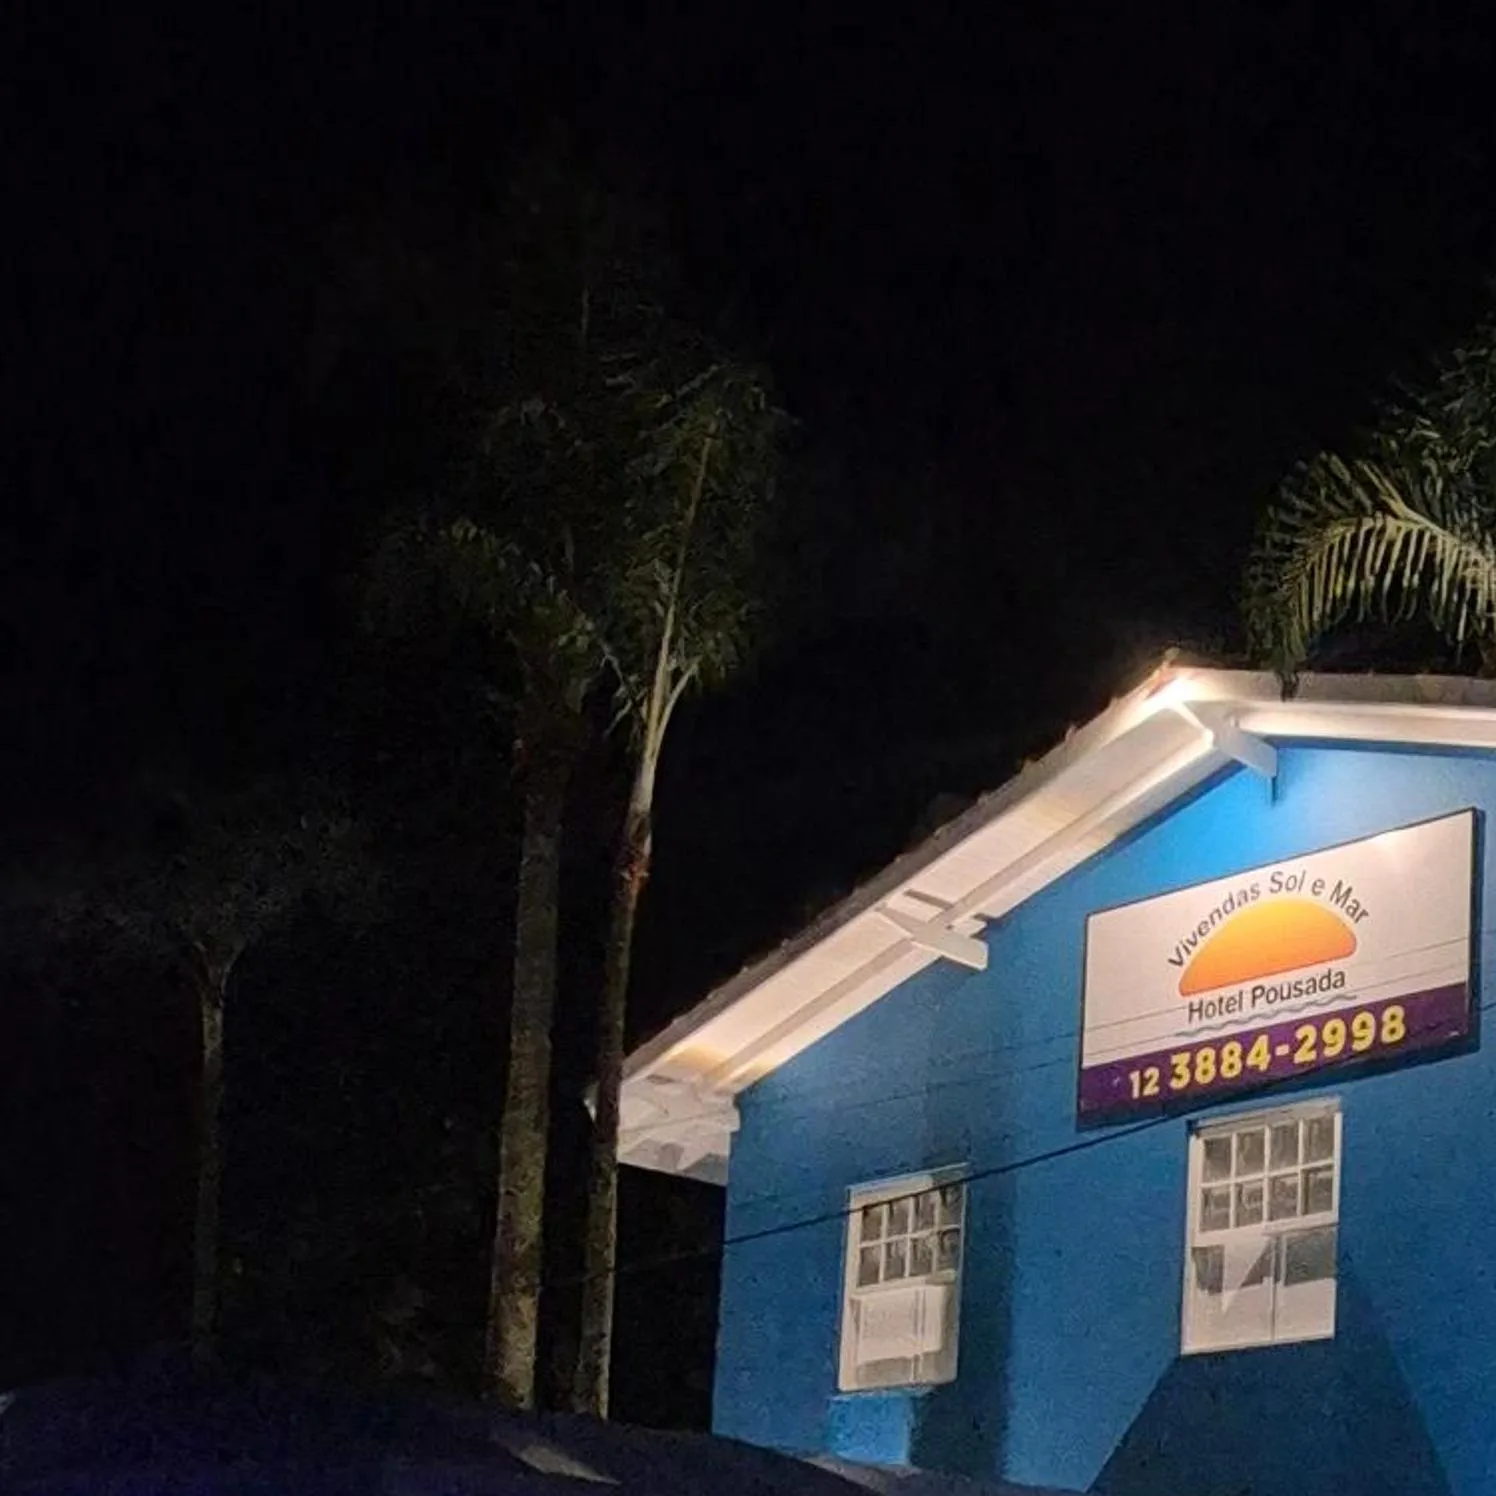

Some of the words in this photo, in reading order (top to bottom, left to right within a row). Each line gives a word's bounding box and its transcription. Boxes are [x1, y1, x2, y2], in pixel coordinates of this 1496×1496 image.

[1167, 882, 1261, 968] Vivendas
[1268, 870, 1307, 895] Sol
[1311, 877, 1326, 897] e
[1329, 879, 1370, 925] Mar
[1187, 990, 1246, 1024] Hotel
[1251, 968, 1346, 1009] Pousada
[1128, 1066, 1160, 1099] 12
[1169, 1006, 1407, 1090] 3884-2998
